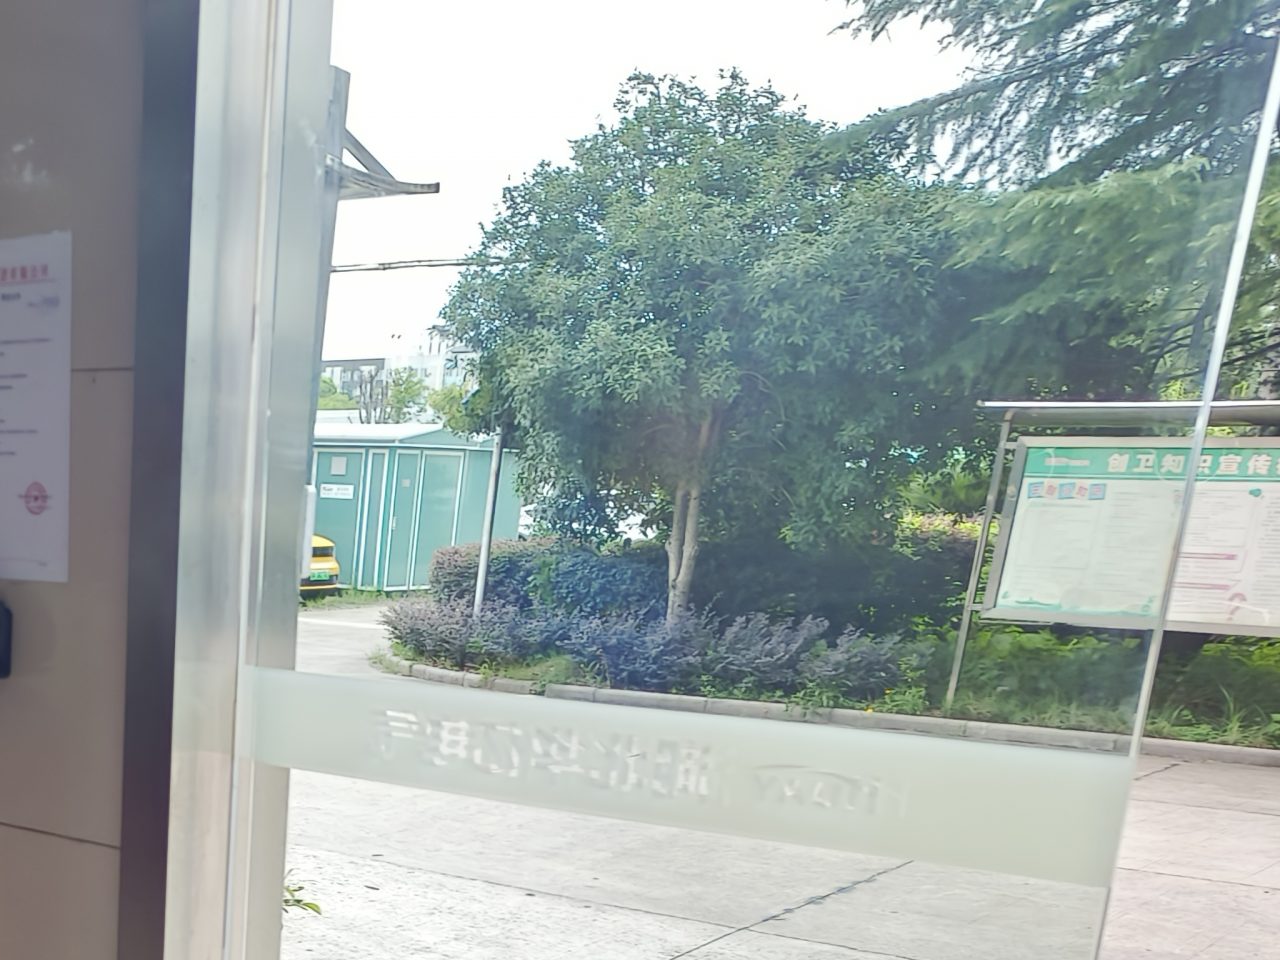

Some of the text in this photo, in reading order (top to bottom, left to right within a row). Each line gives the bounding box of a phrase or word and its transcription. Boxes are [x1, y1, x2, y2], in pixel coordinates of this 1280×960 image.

[1107, 453, 1280, 475] 创卫知识宣传
